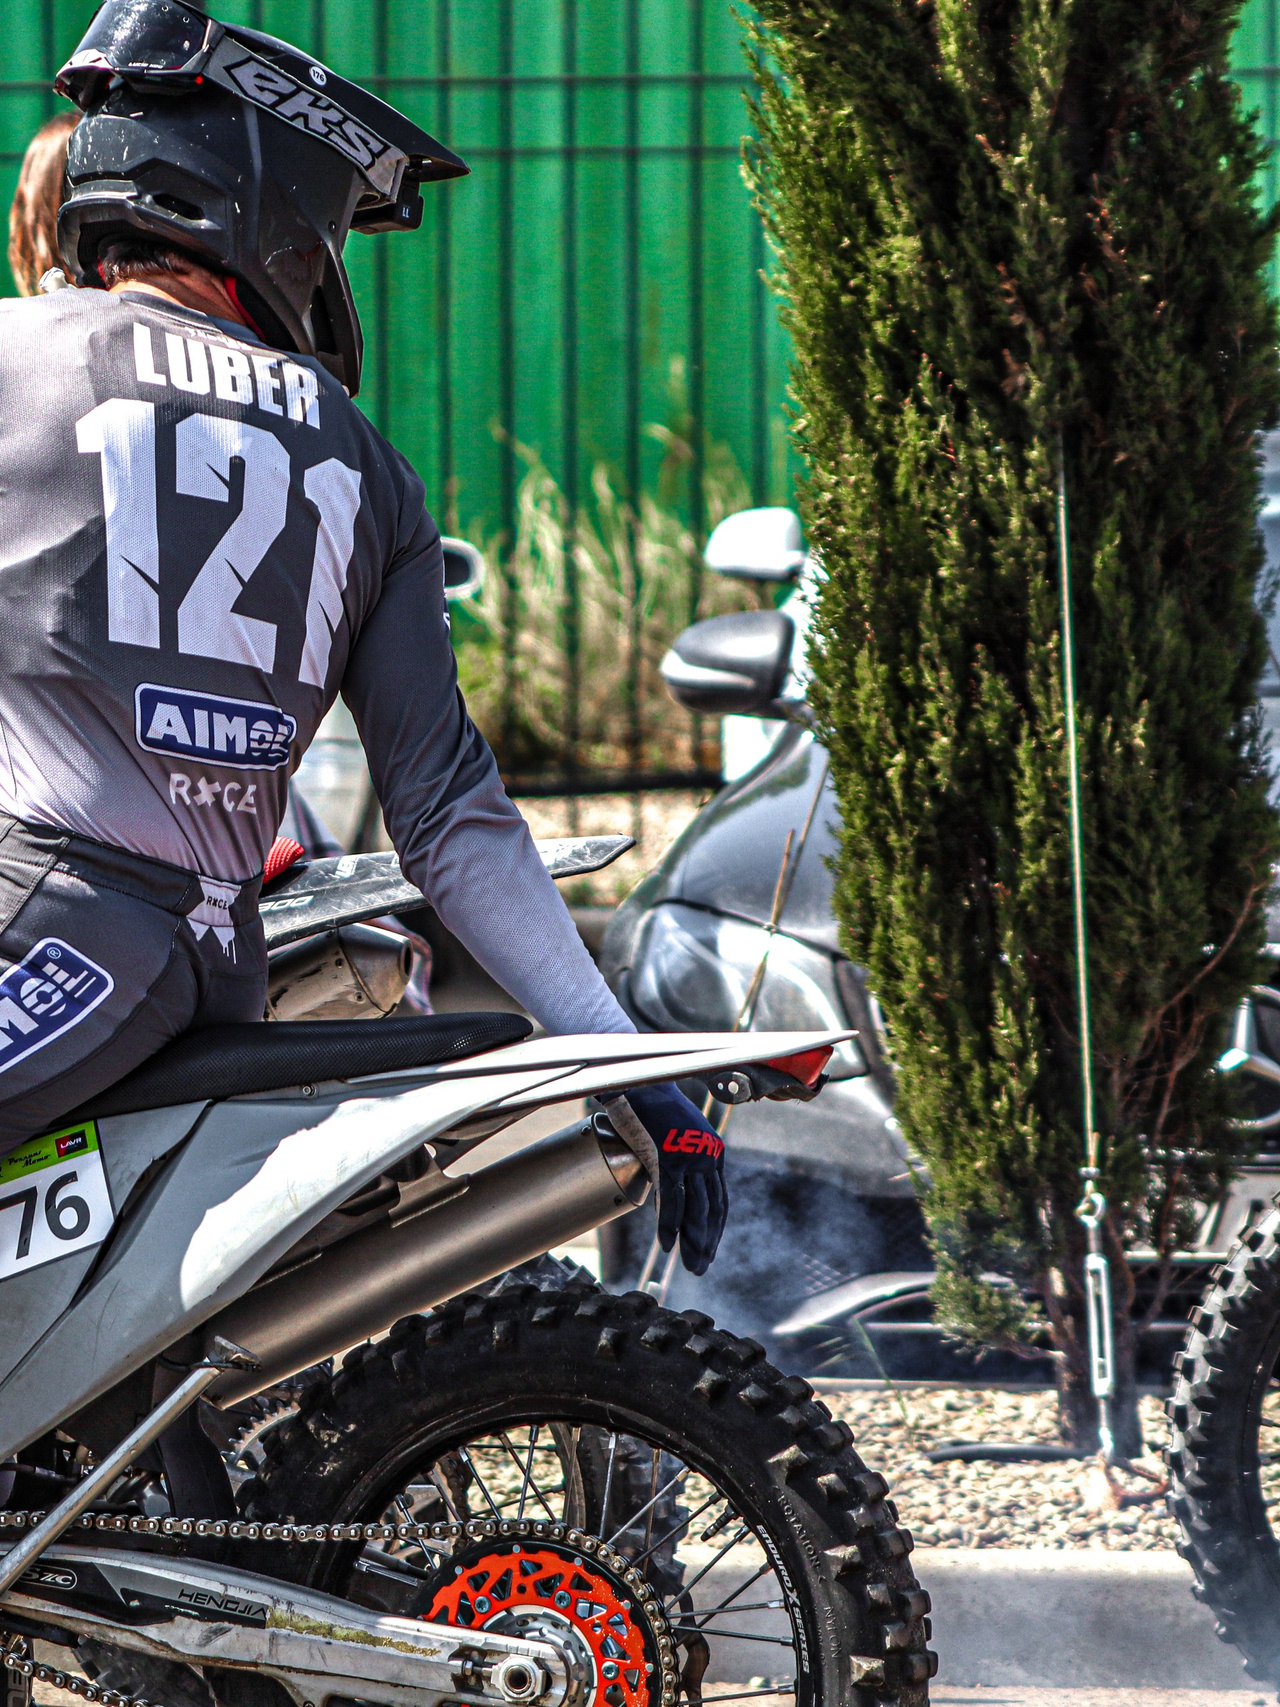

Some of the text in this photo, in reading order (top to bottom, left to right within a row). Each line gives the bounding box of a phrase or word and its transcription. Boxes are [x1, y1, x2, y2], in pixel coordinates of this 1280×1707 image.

[311, 69, 325, 82] 176
[133, 322, 320, 430] LUBER
[75, 397, 362, 689] 121
[60, 1137, 82, 1149] LAVR
[793, 1606, 810, 1674] SERIES
